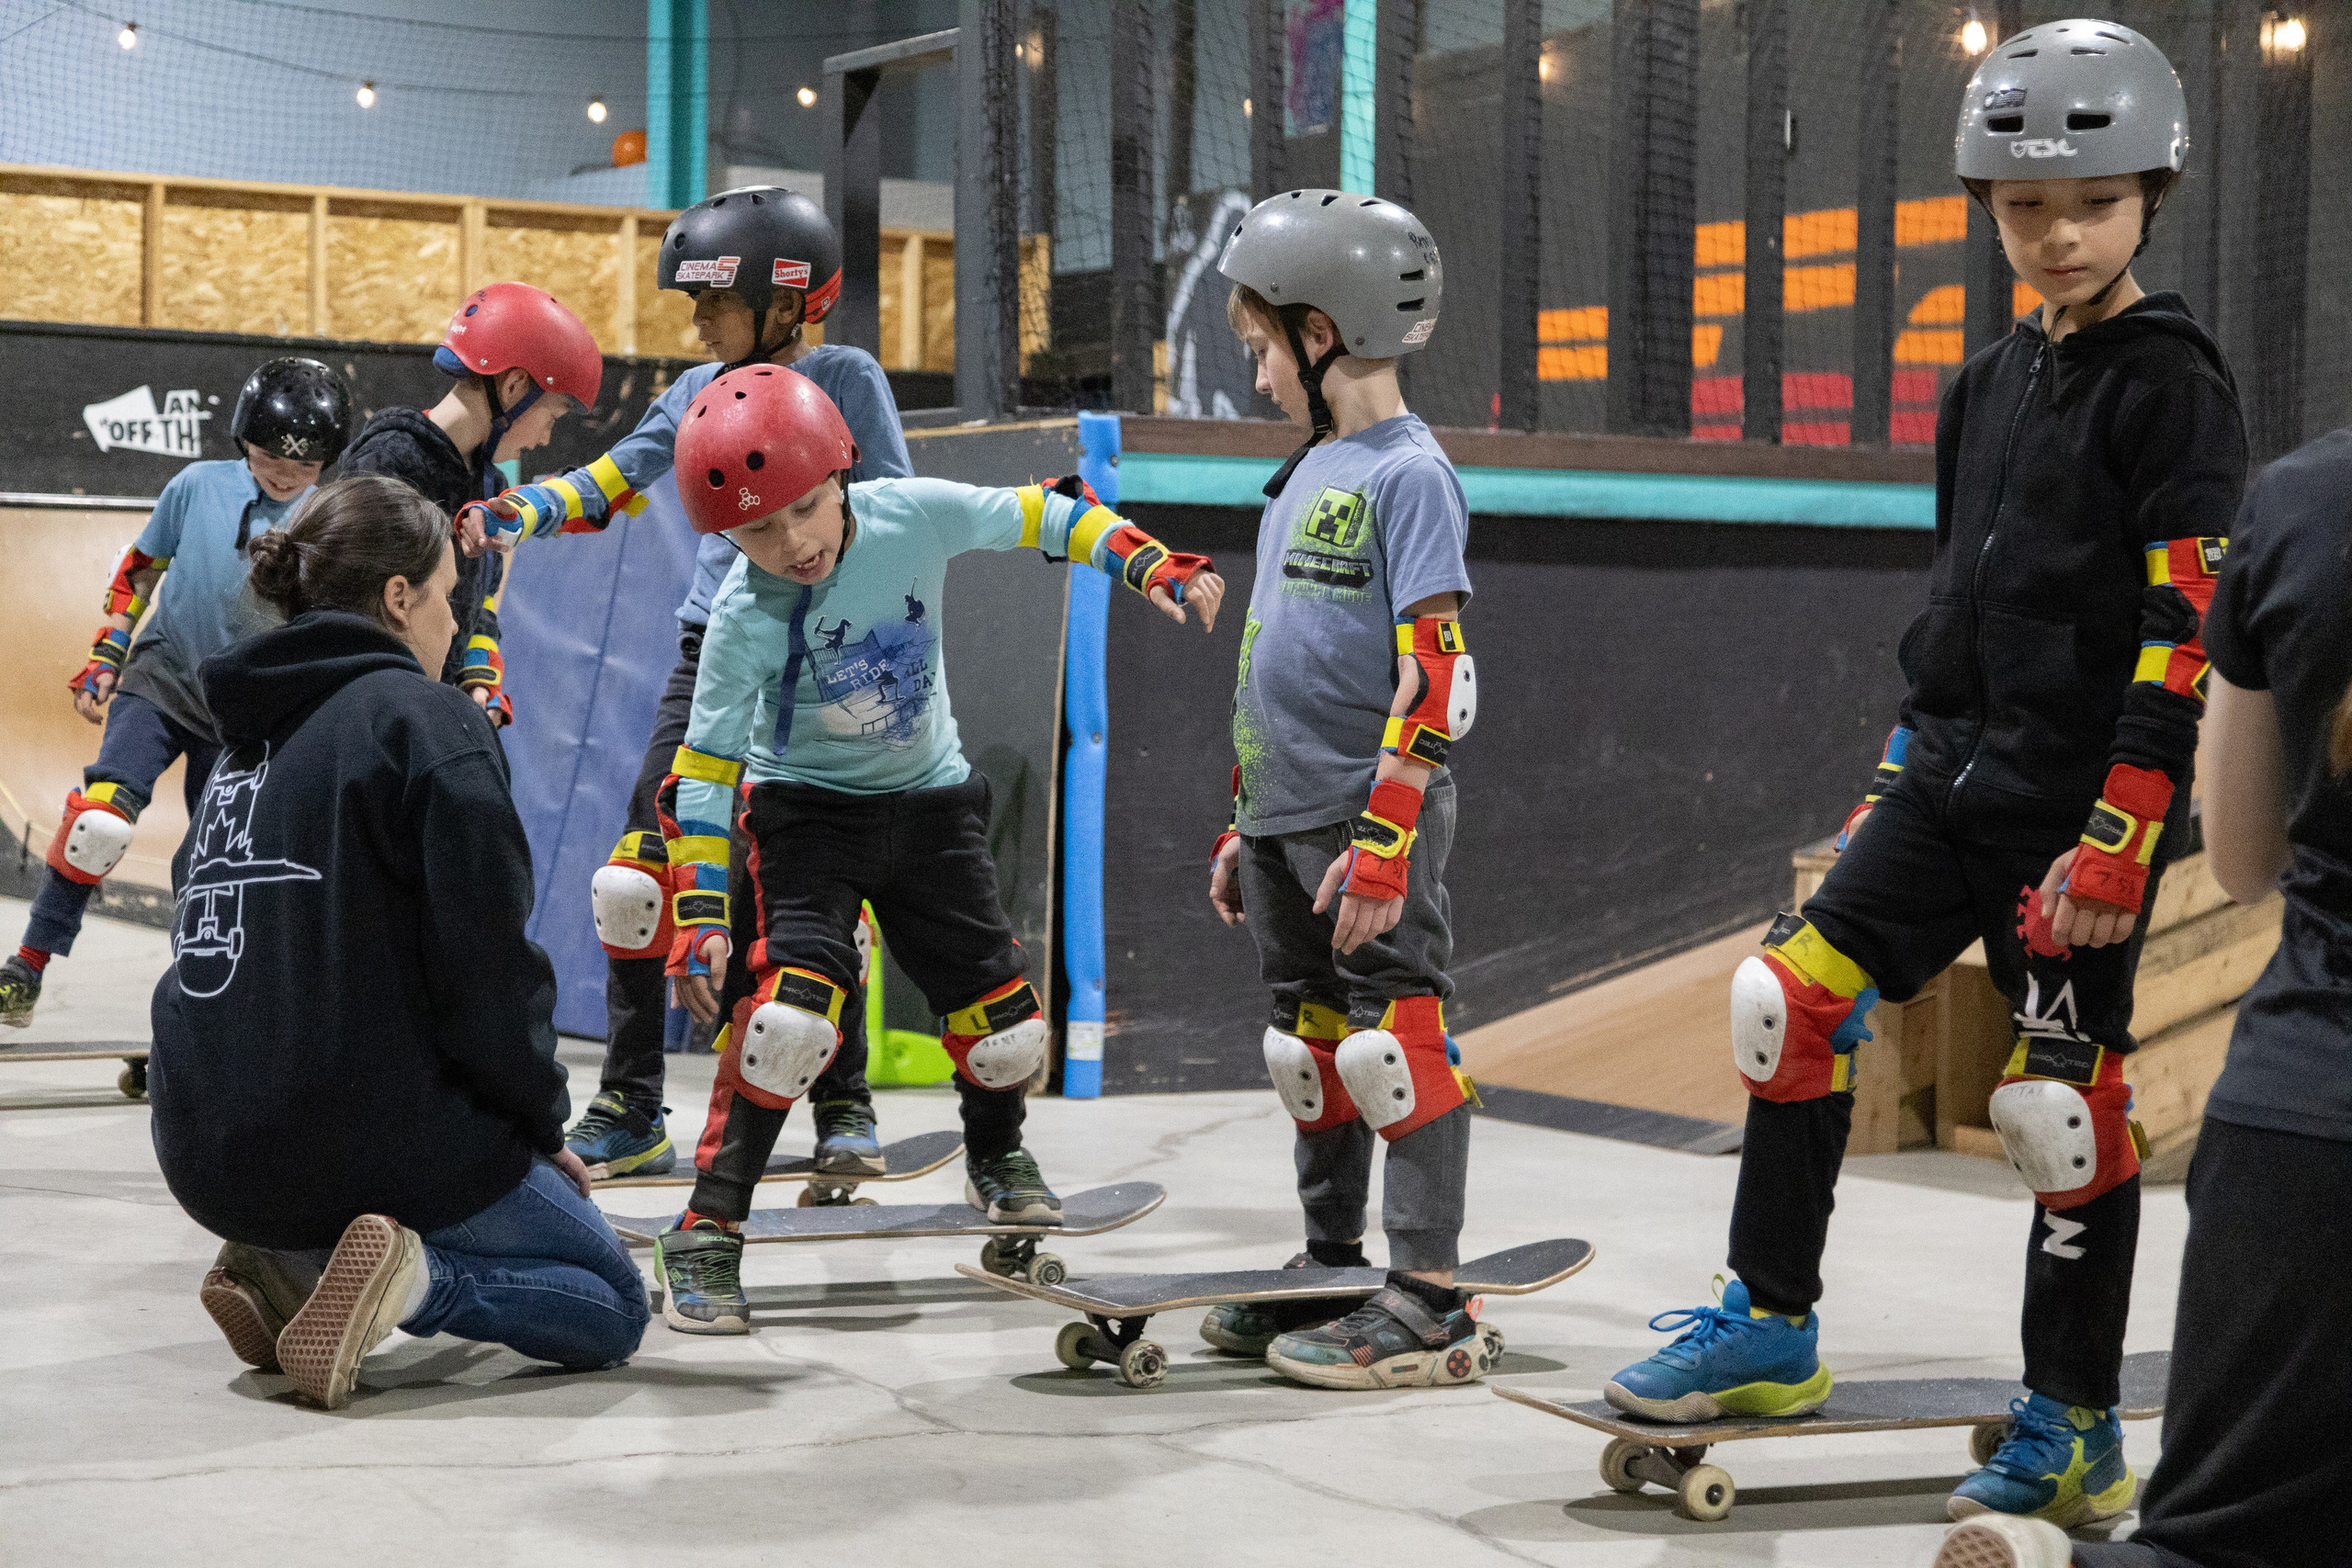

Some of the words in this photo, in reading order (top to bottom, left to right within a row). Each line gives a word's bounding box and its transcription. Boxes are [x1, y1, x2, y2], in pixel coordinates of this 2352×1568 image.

[676, 271, 725, 280] SKATEPARK
[681, 262, 717, 271] CINEMA
[1283, 552, 1372, 577] MINECRAFT
[827, 659, 869, 684] LET'S
[904, 658, 928, 680] ALL
[1302, 1010, 1321, 1028] R
